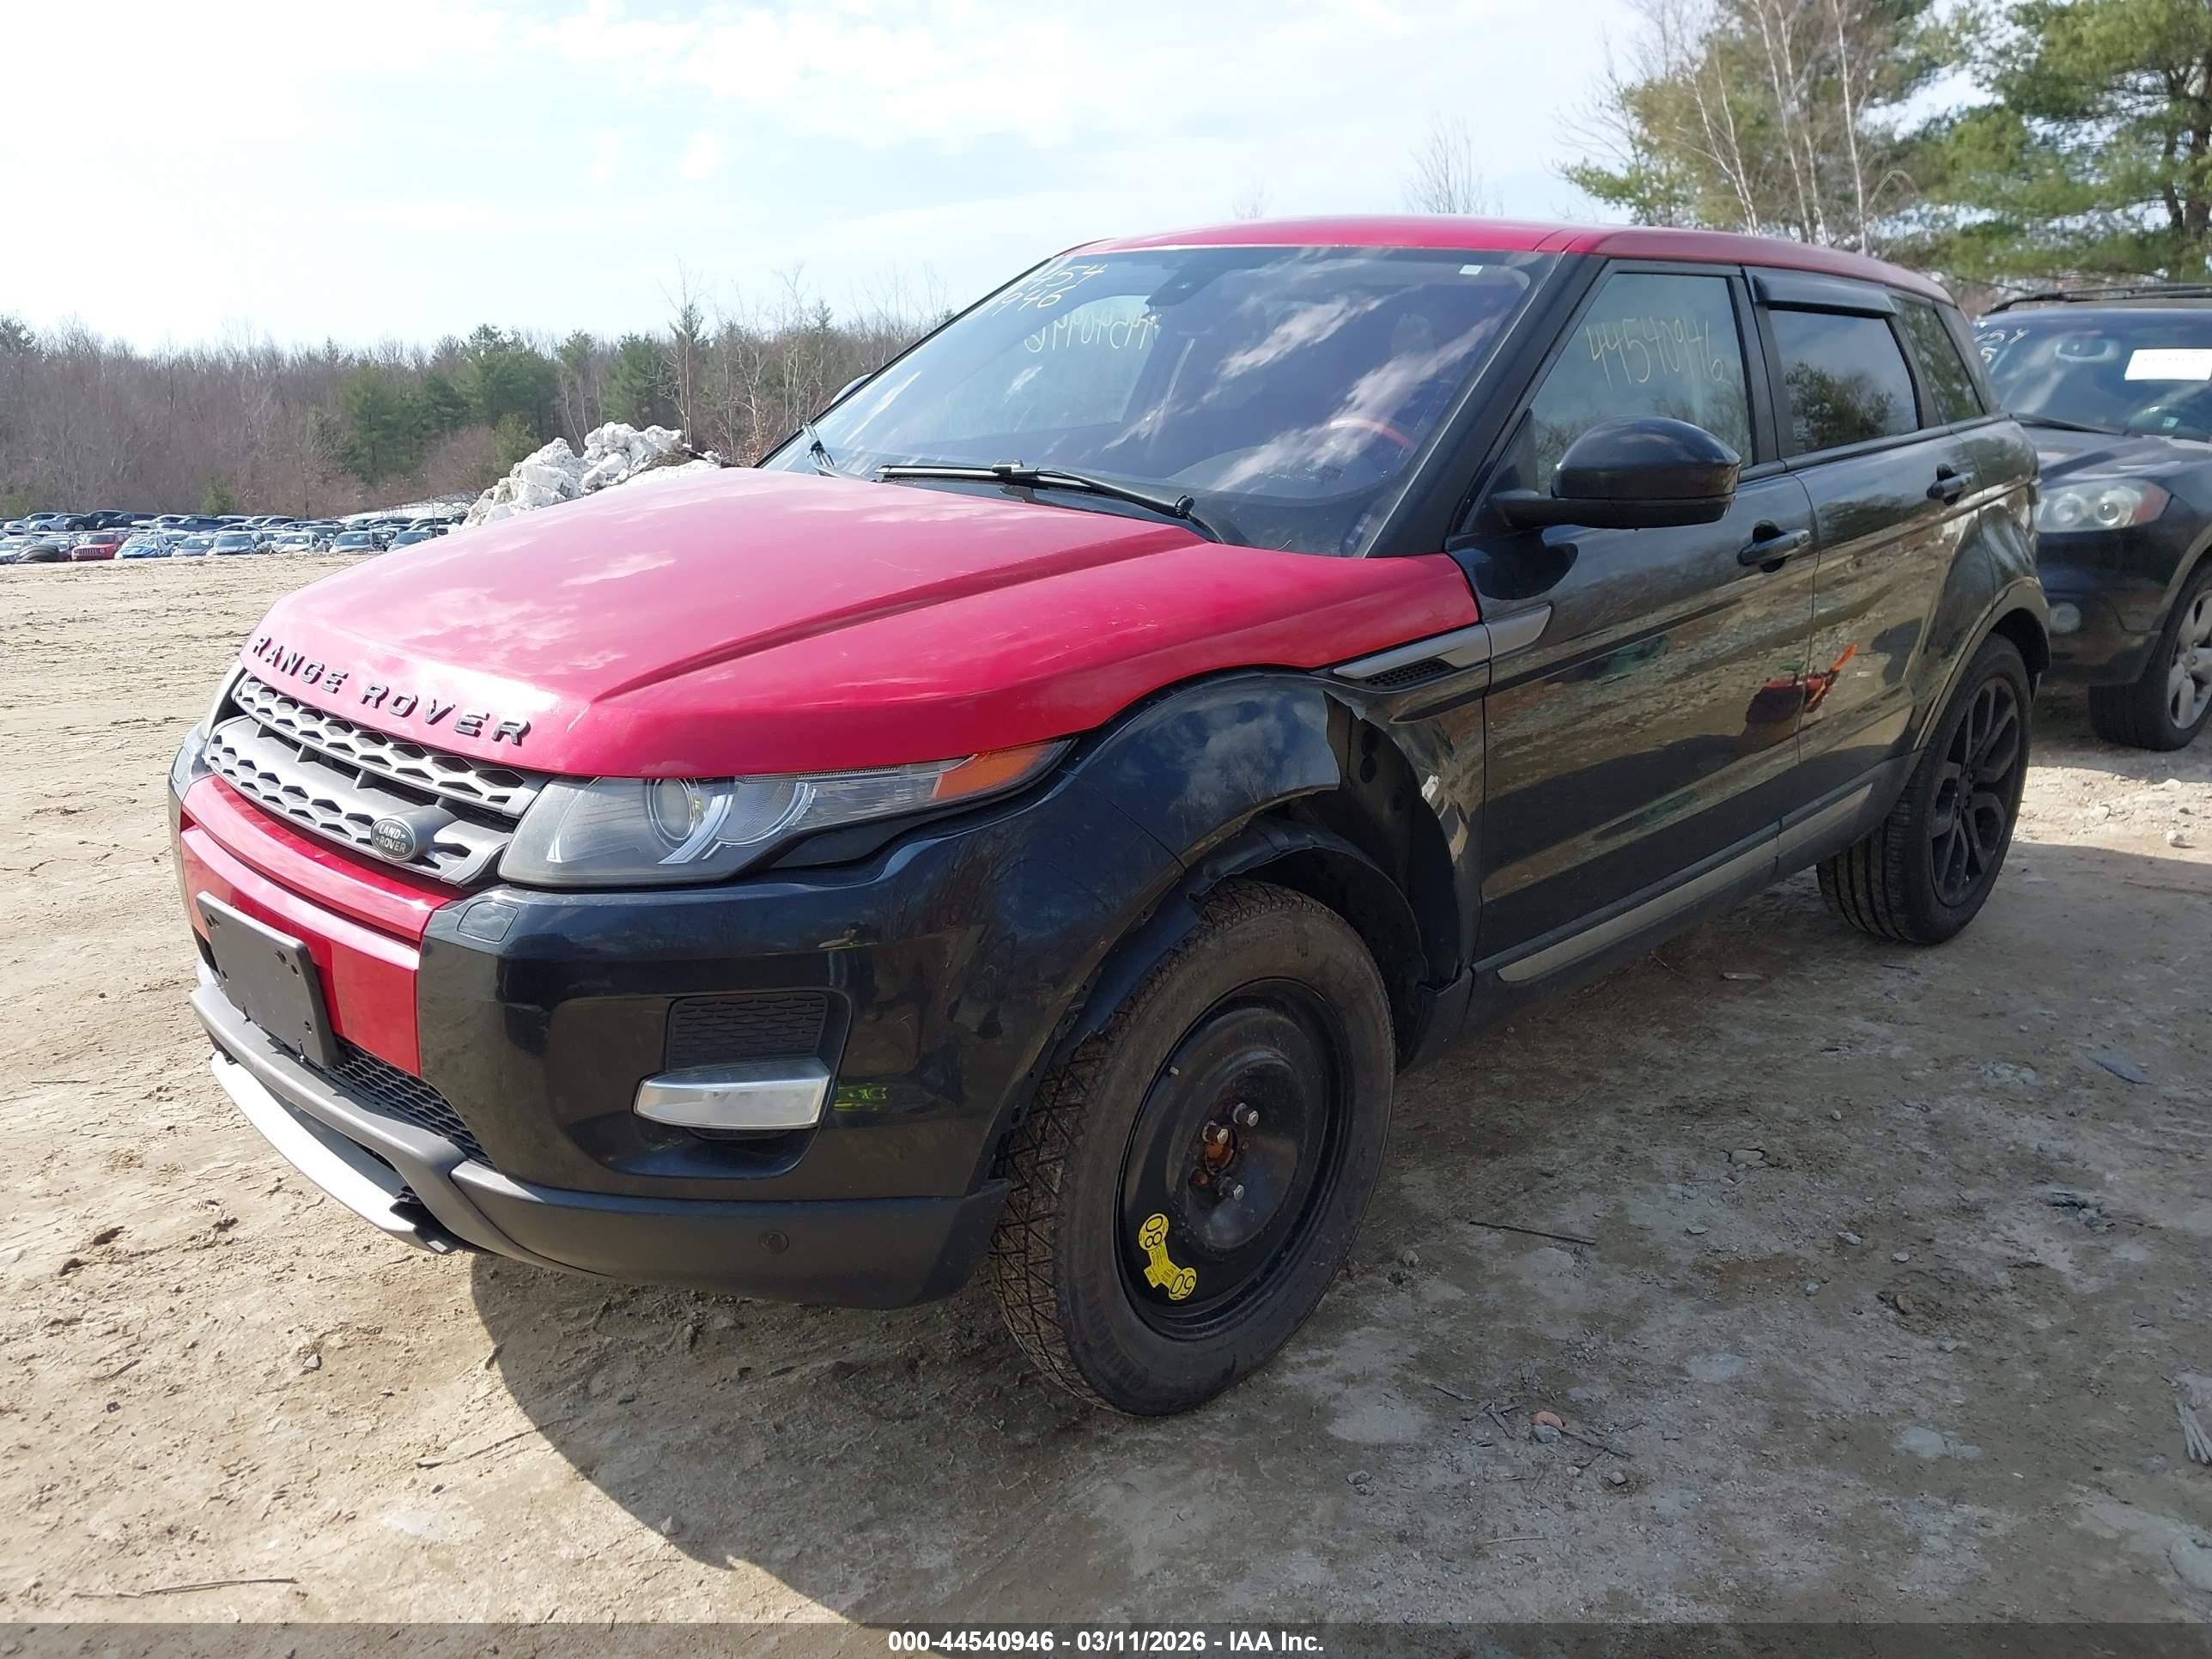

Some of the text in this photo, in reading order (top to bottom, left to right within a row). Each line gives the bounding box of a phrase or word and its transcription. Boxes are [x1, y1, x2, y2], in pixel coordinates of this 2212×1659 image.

[1586, 315, 1725, 391] 44540946
[252, 632, 532, 746] RANGE ROVER
[378, 823, 402, 840] LAND
[379, 836, 407, 854] ROVER
